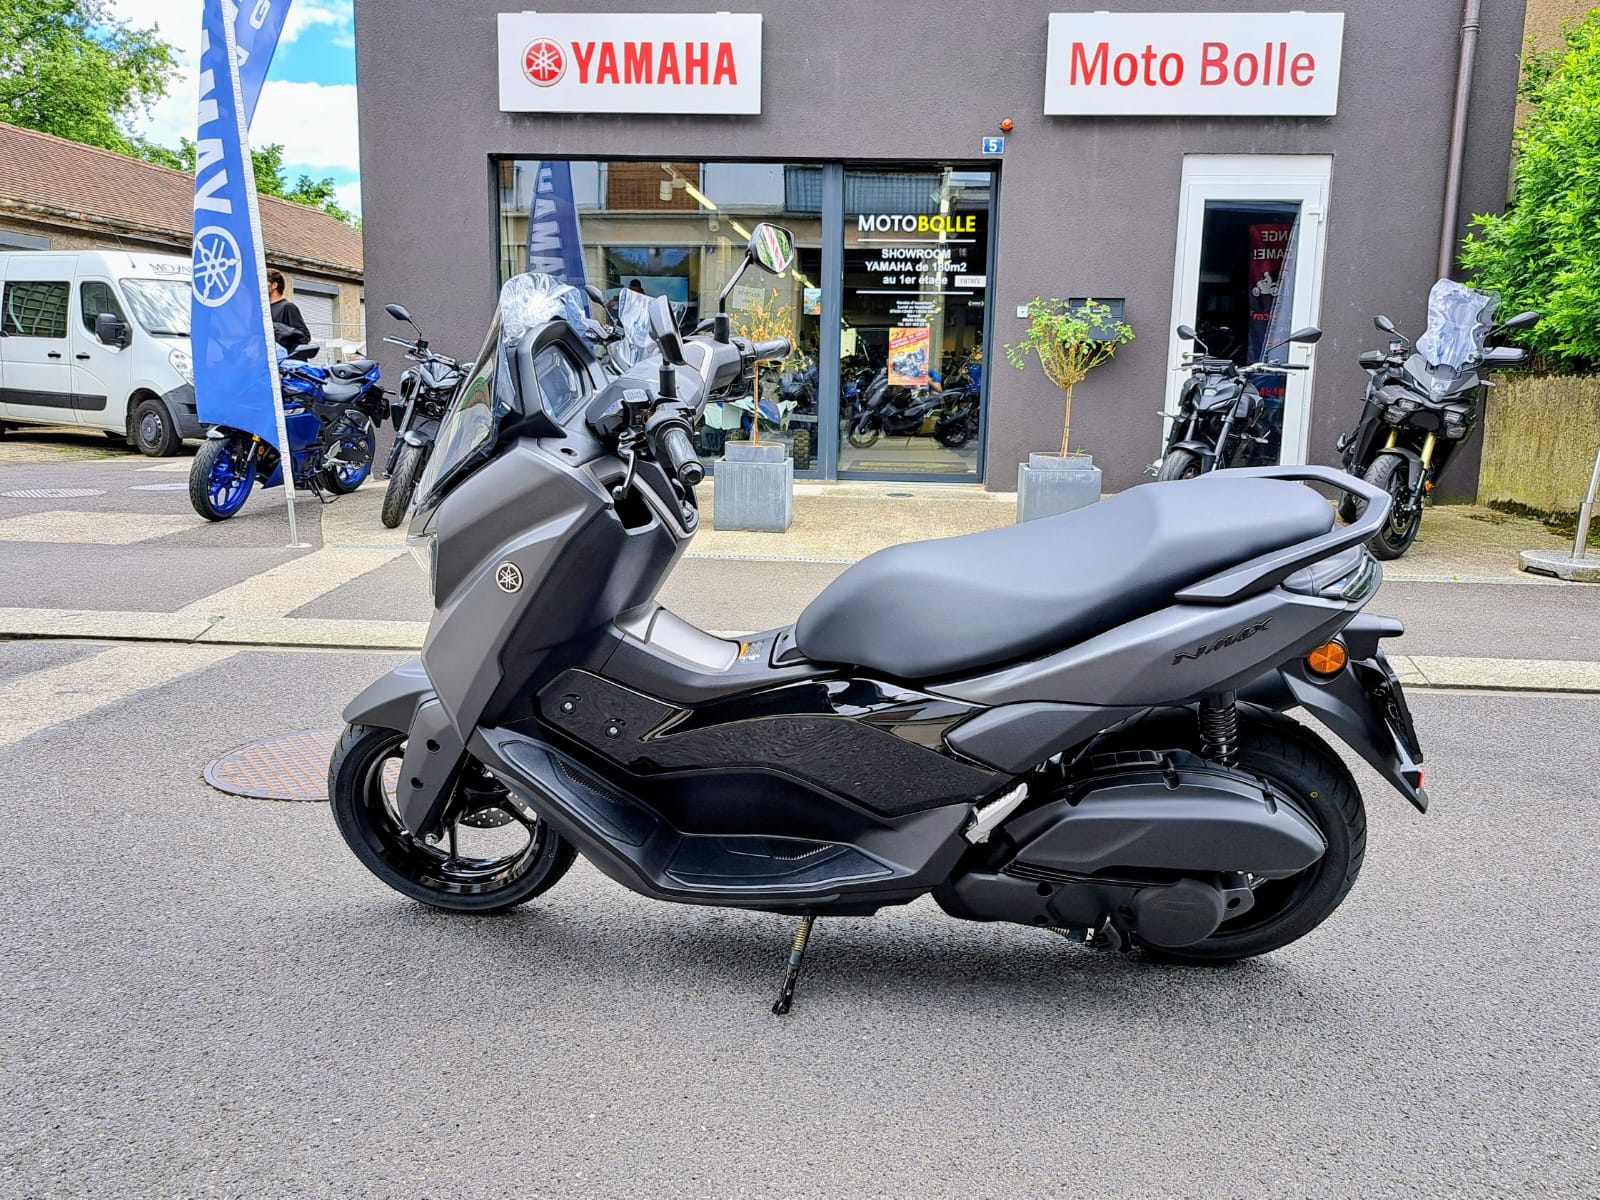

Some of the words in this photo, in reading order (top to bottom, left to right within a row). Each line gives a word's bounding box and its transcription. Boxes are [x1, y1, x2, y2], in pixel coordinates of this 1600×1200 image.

[571, 42, 738, 86] YAMAHA
[1070, 42, 1184, 87] Moto
[1200, 42, 1315, 87] Bolle
[988, 139, 998, 152] 5
[858, 215, 976, 232] MOTOBOLLE
[881, 248, 951, 259] SHOWROOM
[865, 261, 913, 272] YAMAHA
[915, 261, 928, 272] de
[933, 262, 967, 272] 180m2
[882, 275, 896, 285] au
[899, 274, 917, 285] 1er
[918, 274, 948, 287] étage
